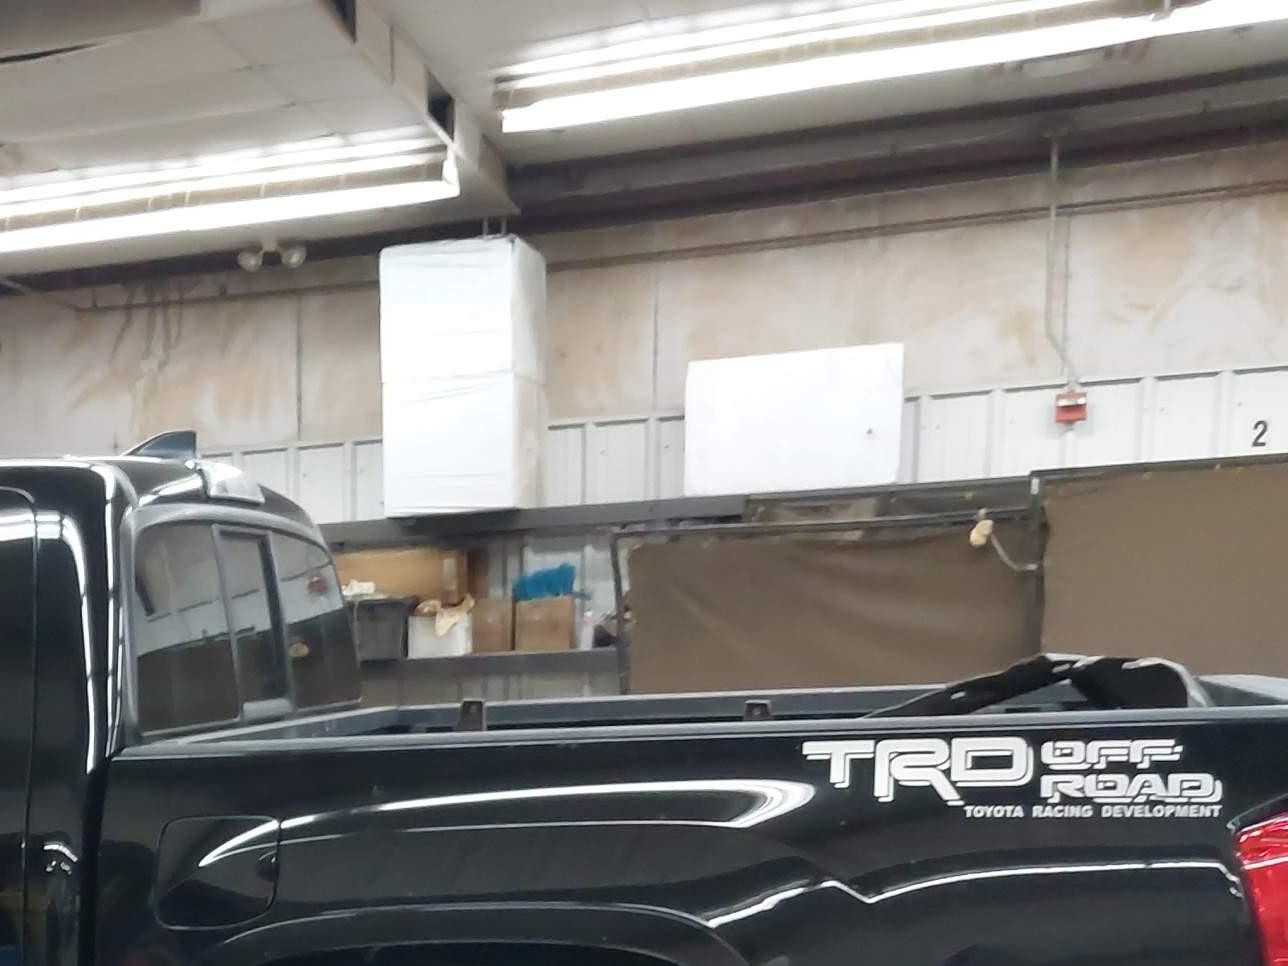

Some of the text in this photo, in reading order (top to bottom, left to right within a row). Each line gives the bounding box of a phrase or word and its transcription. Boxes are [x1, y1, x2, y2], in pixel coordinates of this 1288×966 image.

[1252, 420, 1268, 447] 2
[1040, 738, 1184, 770] OFF
[802, 736, 1035, 807] TRD
[1039, 772, 1223, 804] ROAD
[964, 803, 1223, 818] TOYOTA RACING DEVELOPMENT
